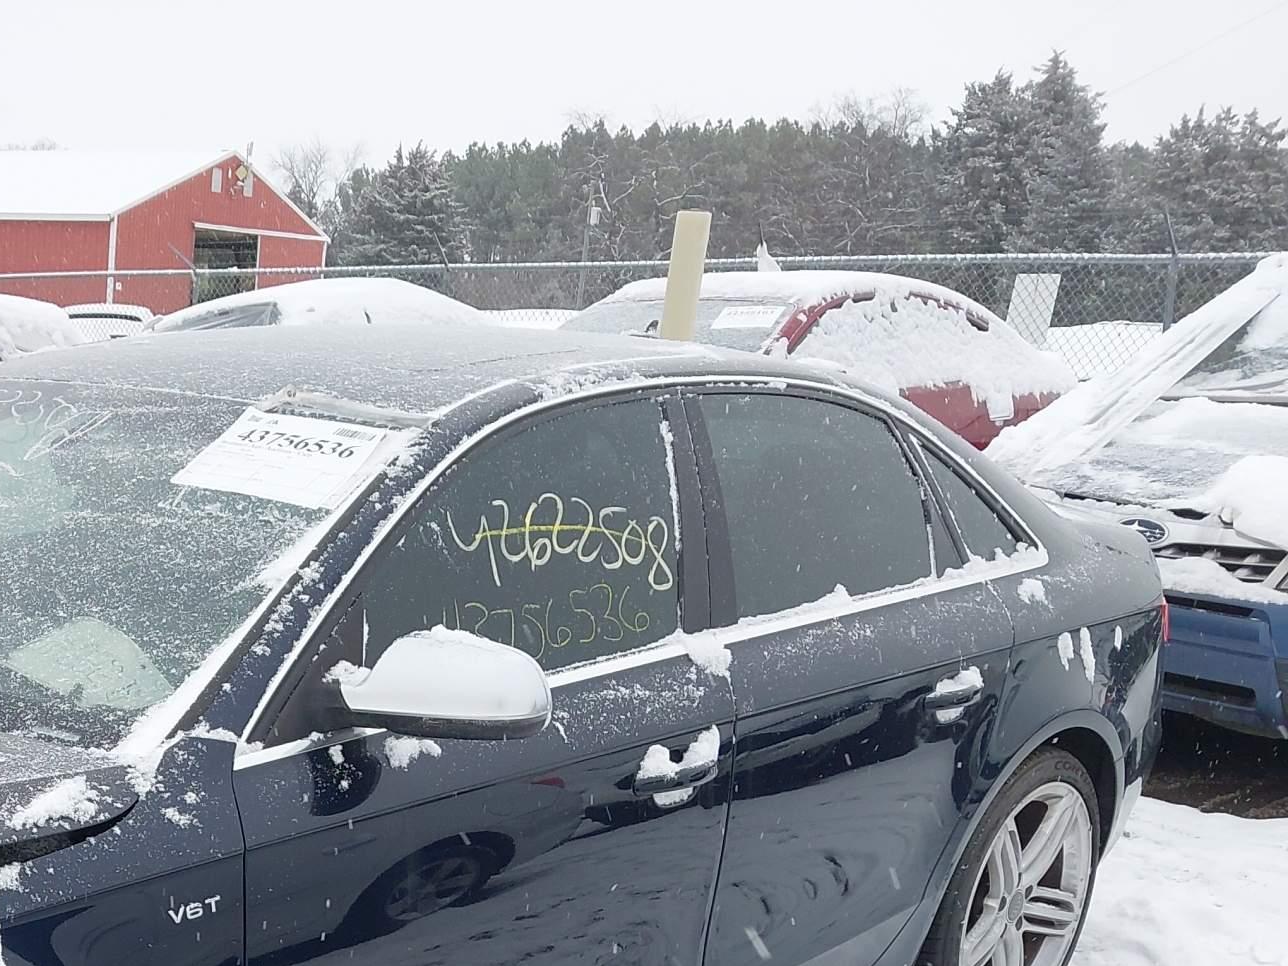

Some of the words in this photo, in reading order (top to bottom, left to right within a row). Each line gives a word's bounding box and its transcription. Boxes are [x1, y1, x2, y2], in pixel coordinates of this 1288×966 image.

[237, 428, 361, 460] 43756536
[444, 492, 674, 591] 42622508
[167, 894, 221, 924] V6T
